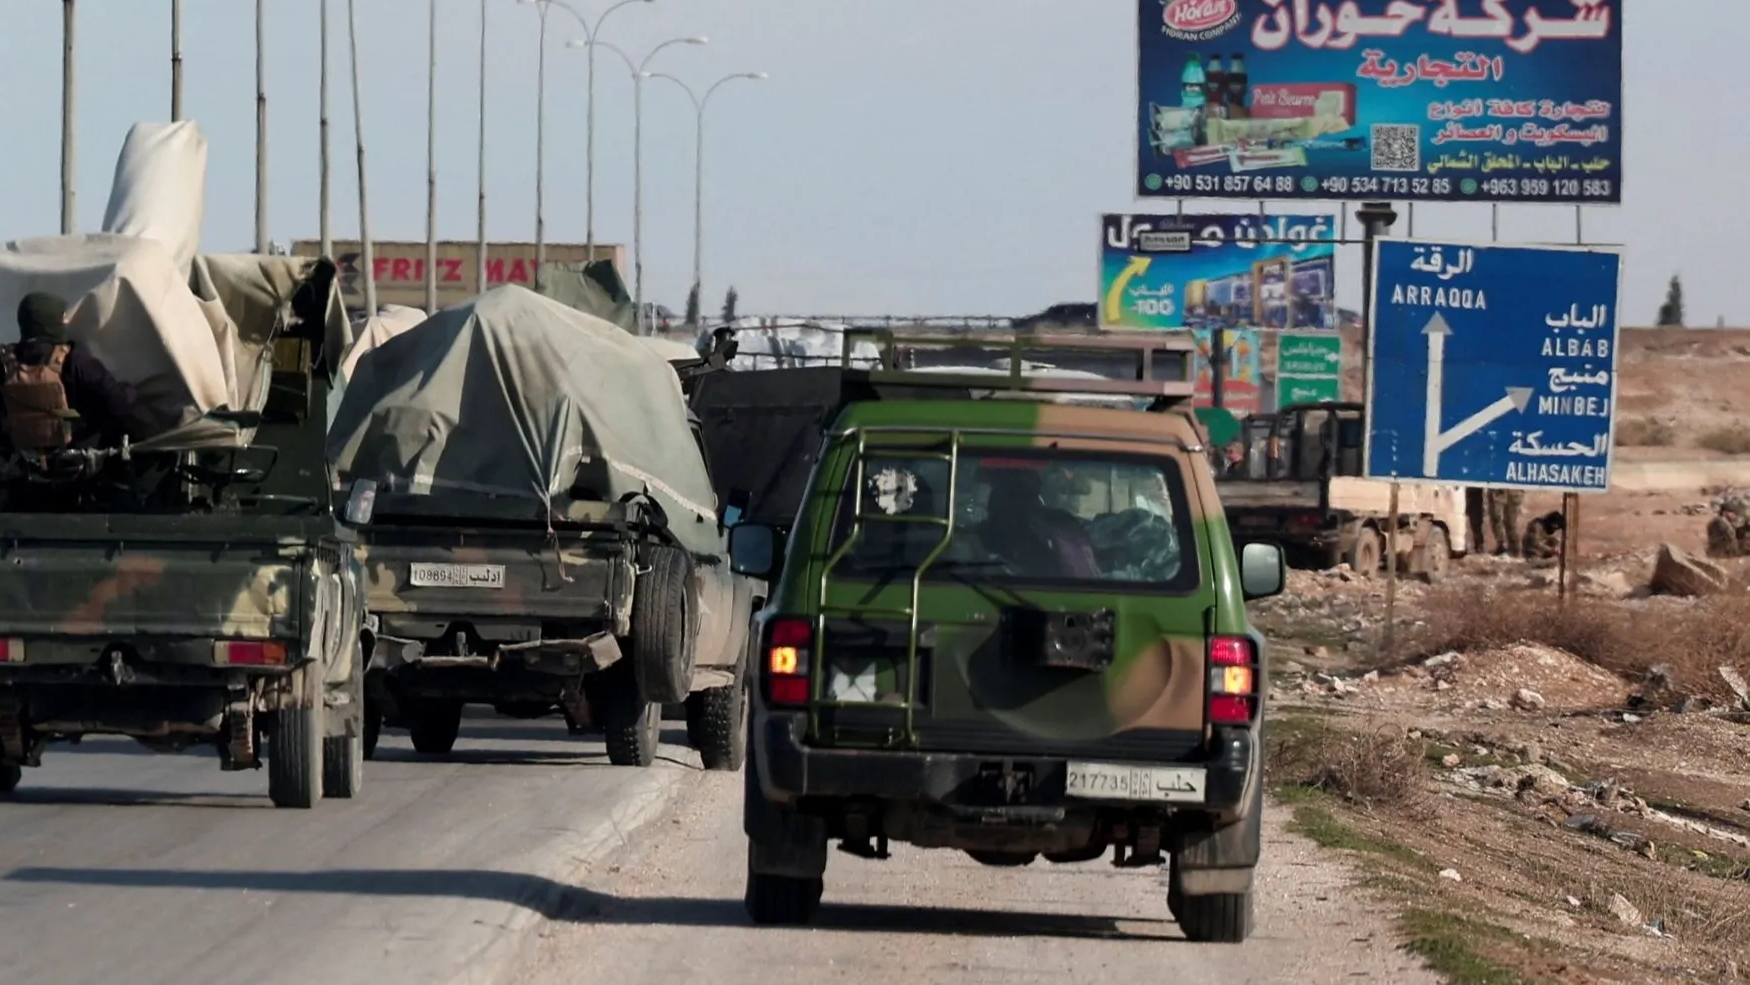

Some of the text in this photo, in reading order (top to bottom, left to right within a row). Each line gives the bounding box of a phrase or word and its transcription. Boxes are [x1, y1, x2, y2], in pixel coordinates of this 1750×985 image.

[1357, 47, 1504, 88] التجارية
[1165, 174, 1190, 190] +90
[1195, 174, 1219, 190] 531
[1253, 175, 1270, 192] 64
[1322, 177, 1347, 193] +90
[1351, 177, 1378, 193] 534
[1382, 177, 1407, 194] 713
[1411, 178, 1428, 194] 52
[1481, 179, 1517, 195] +963
[1553, 180, 1579, 195] 120
[373, 258, 462, 282] FRIZ
[1410, 246, 1473, 280] الرقة
[1391, 284, 1486, 309] ARRAQQA
[1545, 303, 1607, 334] الباب
[1542, 337, 1609, 357] ALBAB
[1549, 364, 1609, 392] منبج
[1539, 396, 1609, 417] MINBEJ
[1508, 431, 1608, 457] الحسكة
[1506, 462, 1606, 485] ALHASAKEH
